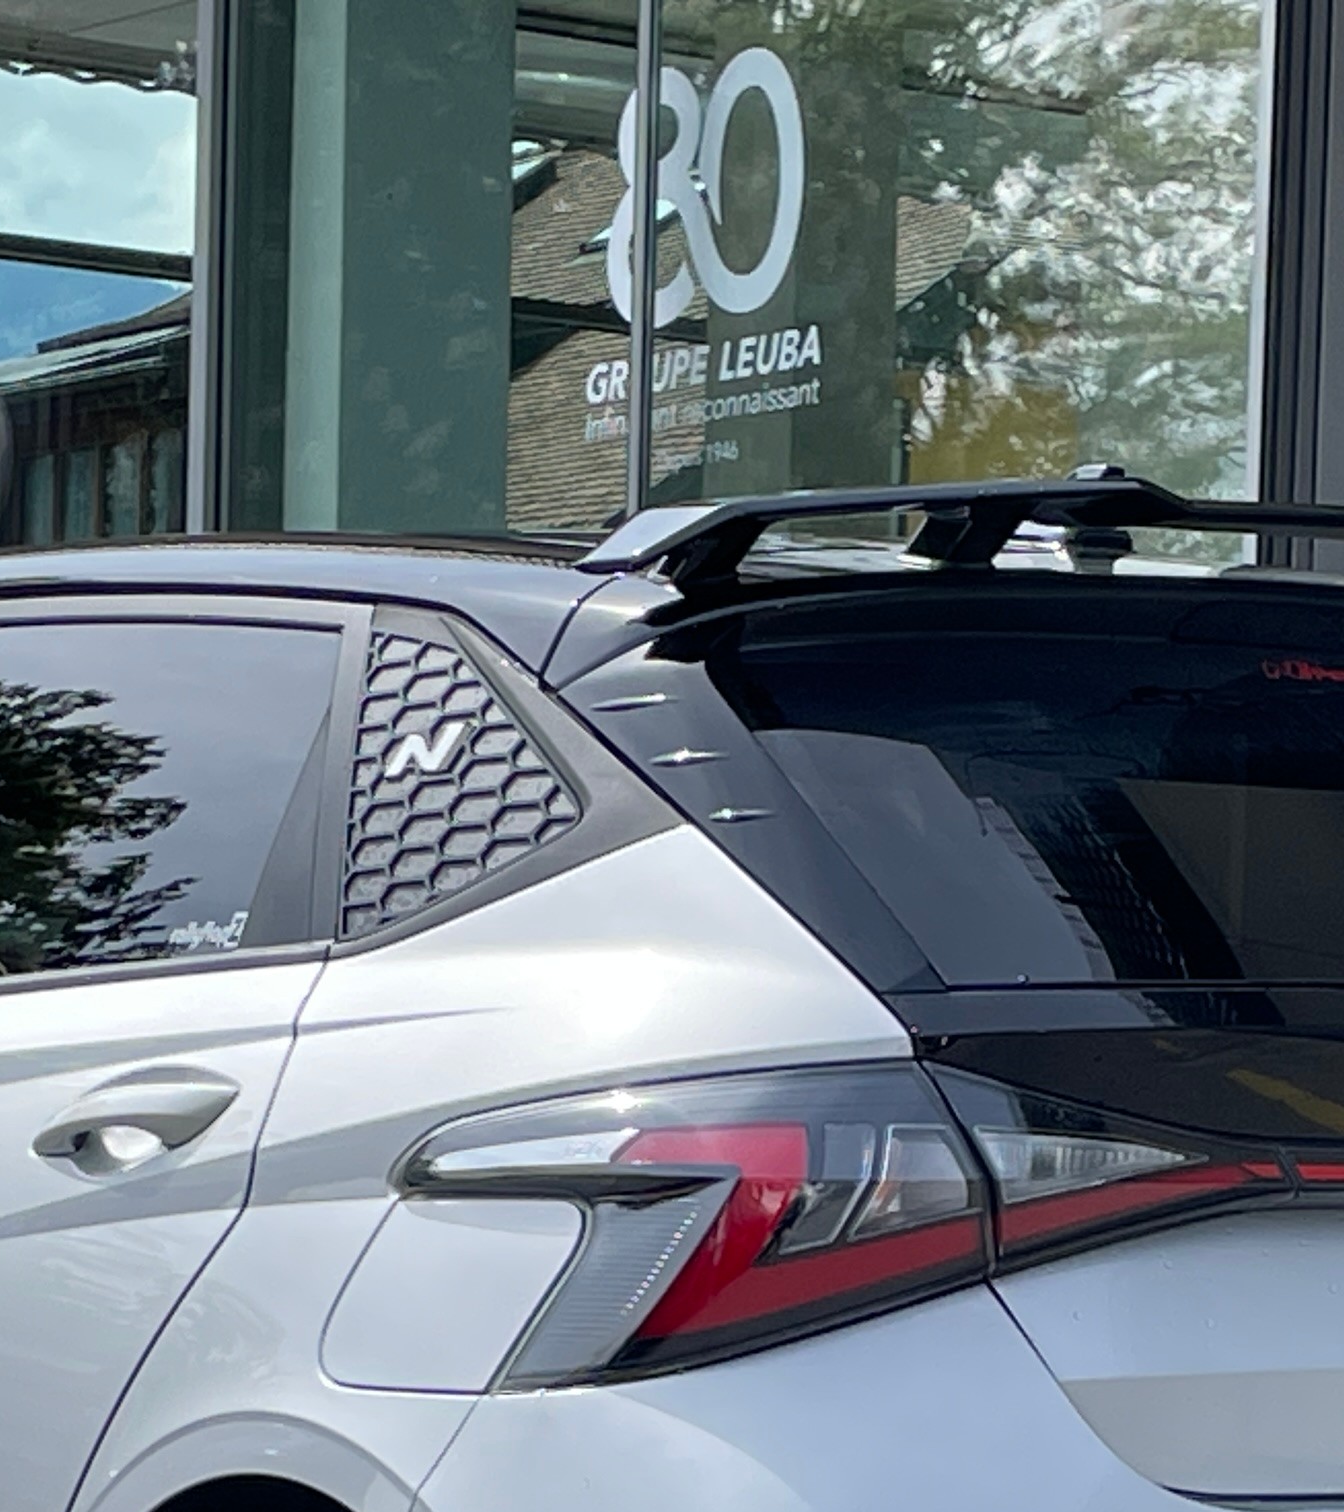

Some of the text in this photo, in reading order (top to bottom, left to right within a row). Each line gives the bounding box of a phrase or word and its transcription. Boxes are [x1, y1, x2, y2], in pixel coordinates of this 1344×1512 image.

[606, 46, 805, 329] 80
[586, 324, 822, 404] GRUPE LEUBA
